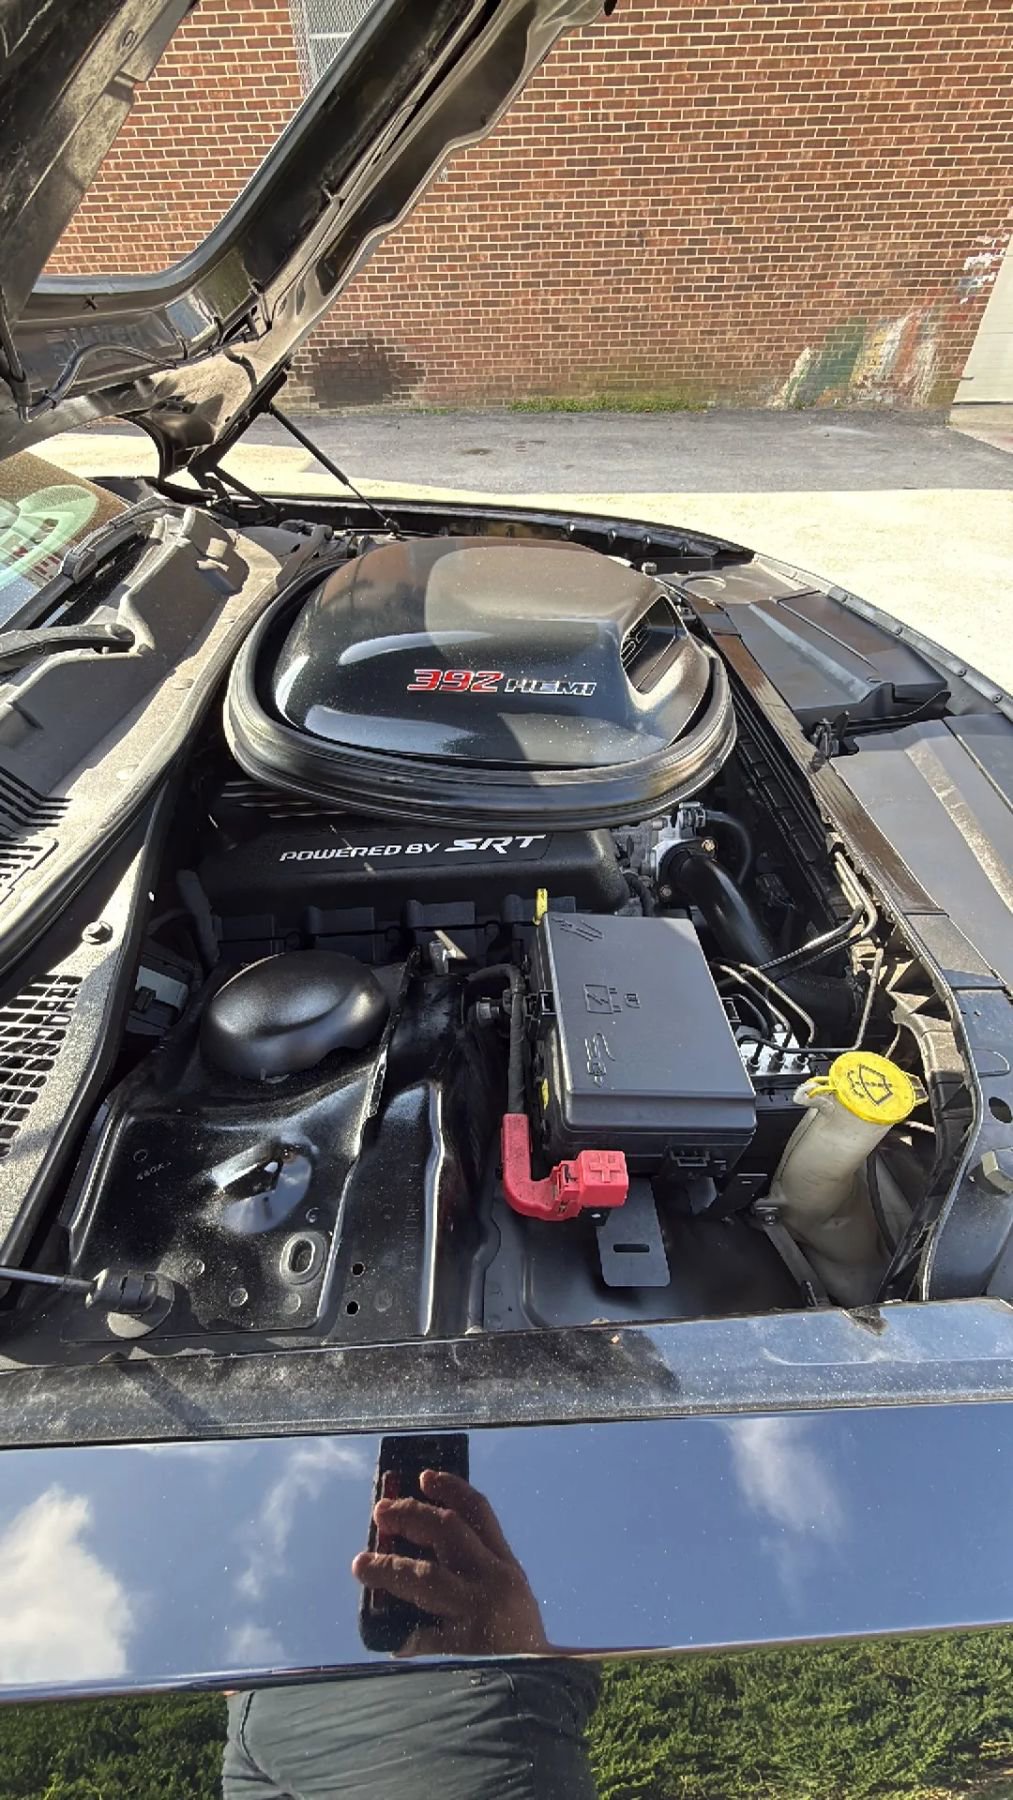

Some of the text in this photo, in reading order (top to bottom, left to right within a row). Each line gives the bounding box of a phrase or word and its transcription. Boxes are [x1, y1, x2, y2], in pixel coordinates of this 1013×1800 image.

[407, 668, 598, 697] 392 HEMI
[279, 834, 547, 862] POWERED BY SRT
